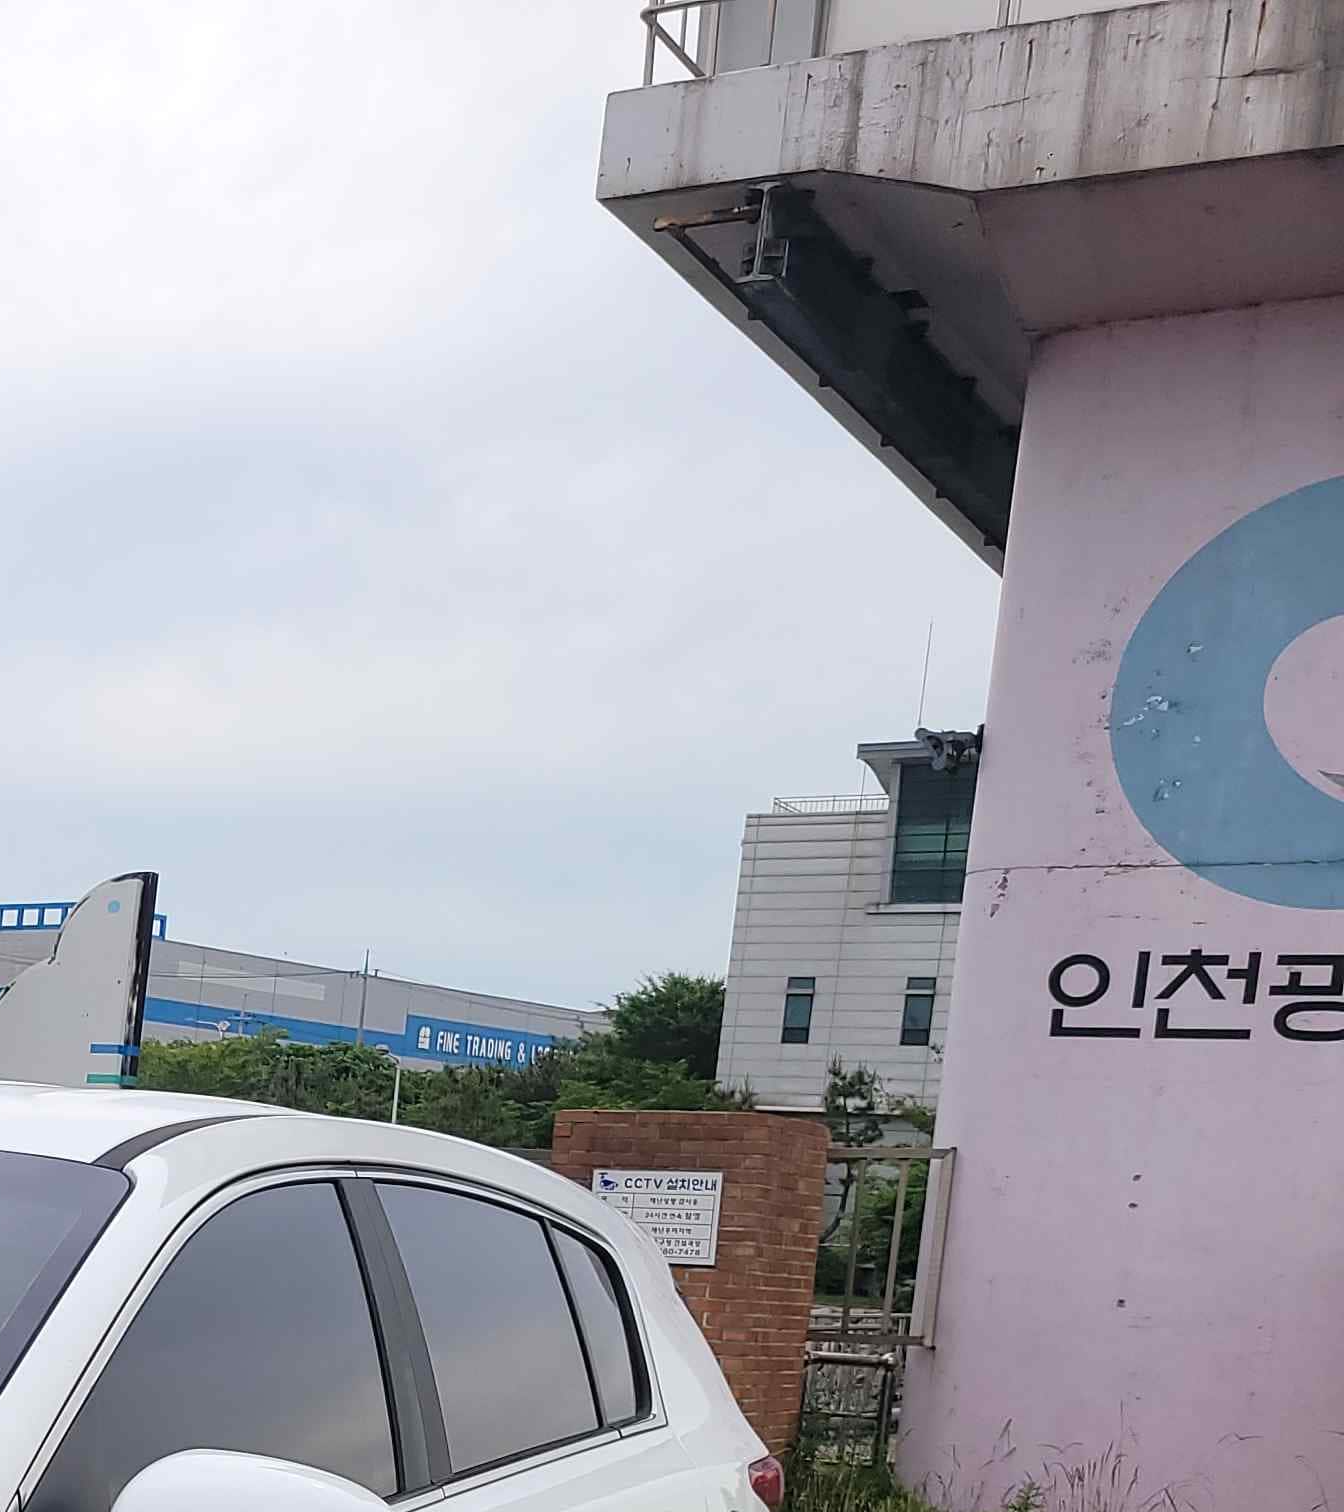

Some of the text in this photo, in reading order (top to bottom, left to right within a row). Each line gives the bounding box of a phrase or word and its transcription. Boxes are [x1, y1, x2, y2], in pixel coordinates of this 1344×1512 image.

[1048, 949, 1344, 1041] 인천공
[436, 1031, 460, 1054] FINE
[466, 1035, 512, 1060] TRADING
[517, 1042, 526, 1064] &
[624, 1177, 717, 1192] CCTV 설치안내
